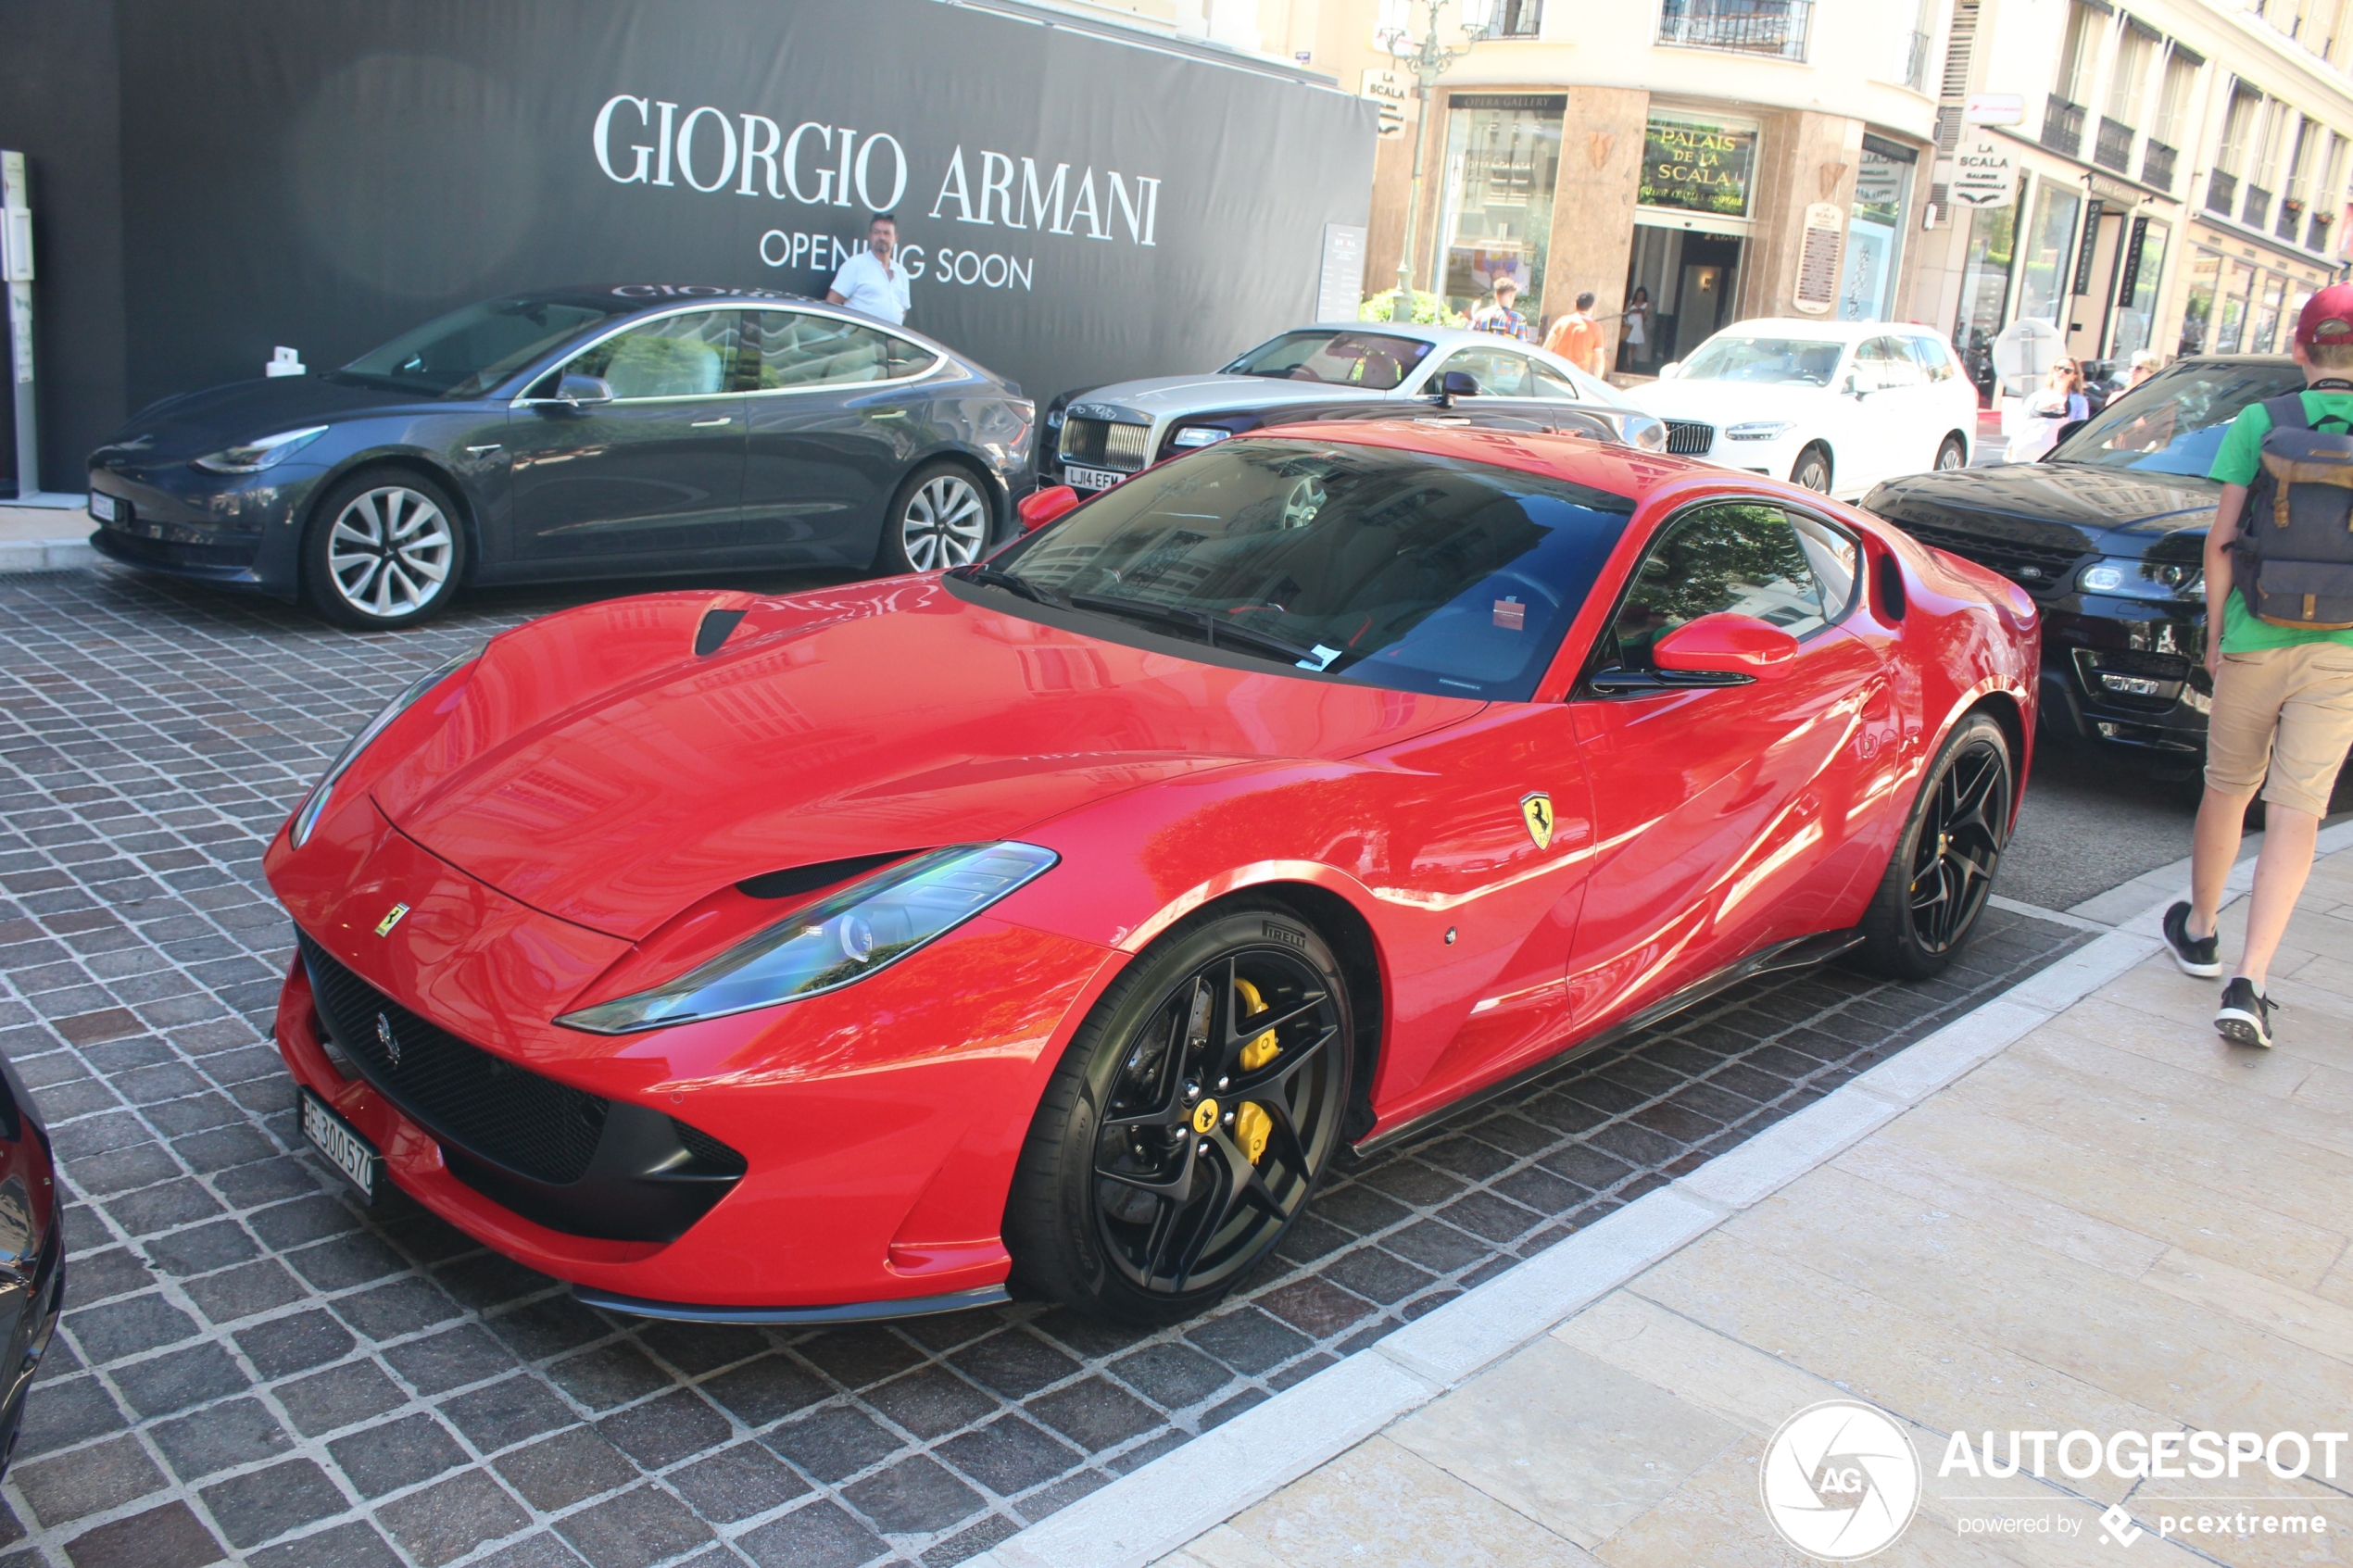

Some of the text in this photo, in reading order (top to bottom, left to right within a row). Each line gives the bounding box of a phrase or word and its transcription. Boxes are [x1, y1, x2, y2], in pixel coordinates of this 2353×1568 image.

[1382, 72, 1394, 83] LA
[1370, 83, 1404, 100] SCALA
[1465, 96, 1550, 107] OPERA GALLERY
[1660, 130, 1736, 152] PALAIS
[1978, 144, 1994, 154] LA
[1673, 149, 1718, 166] DE LA
[1959, 157, 2008, 169] SCALA
[593, 94, 1162, 246] GIORGIO ARMANI
[1657, 164, 1730, 187] SCALA
[760, 230, 1033, 292] OPENG SOON
[1070, 469, 1092, 485] LJ14
[1262, 920, 1306, 949] PIRELLI
